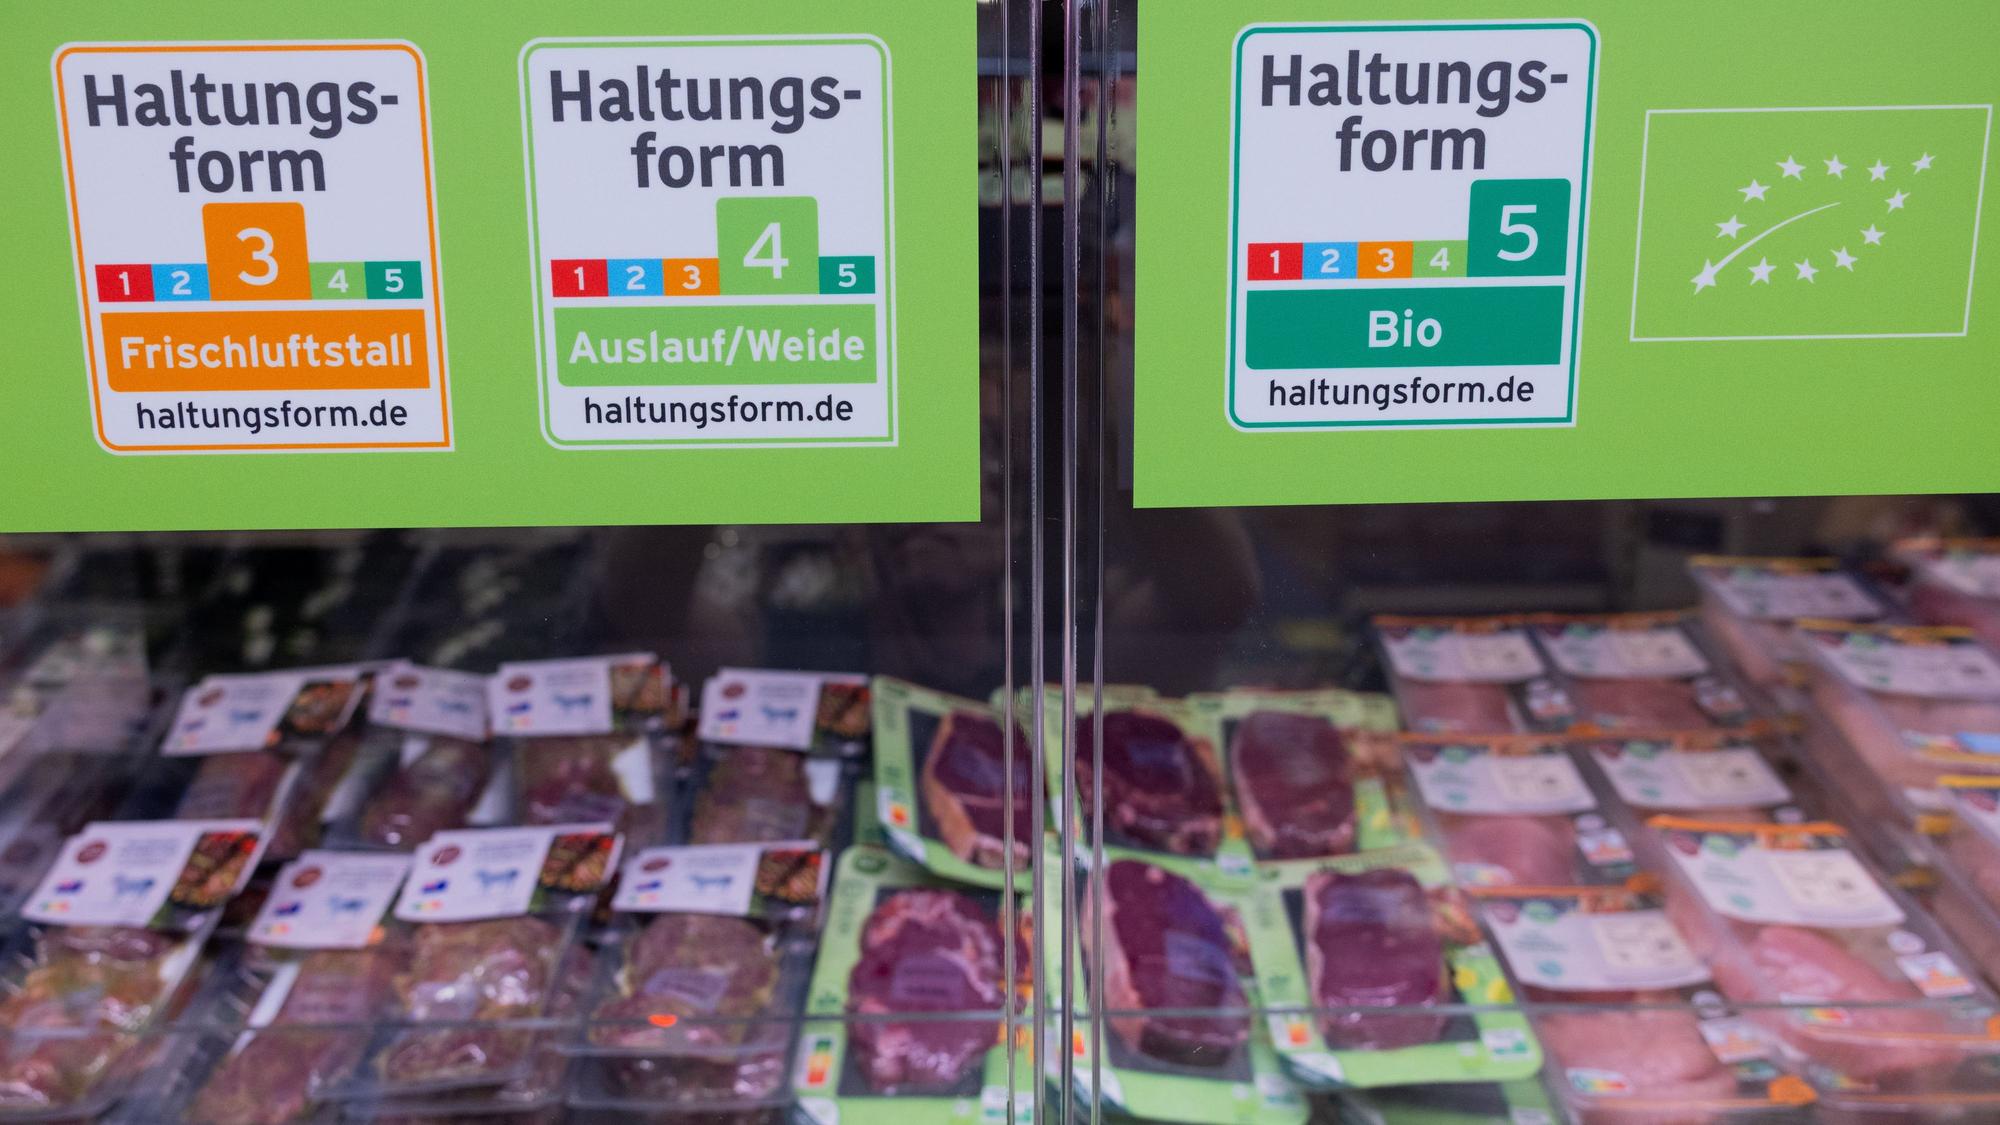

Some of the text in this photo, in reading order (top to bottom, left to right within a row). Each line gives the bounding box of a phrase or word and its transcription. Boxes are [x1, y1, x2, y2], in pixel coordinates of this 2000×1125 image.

[83, 70, 399, 139] Haltungs-
[549, 65, 862, 134] Haltungs-
[1260, 49, 1569, 118] Haltungs-
[169, 136, 326, 194] form
[630, 131, 785, 189] form
[1335, 115, 1486, 172] form
[118, 227, 404, 296] 1 2 3 4 5
[574, 222, 857, 291] 1 2 3 4 5
[1269, 204, 1539, 274] 1 2 3 4 5
[120, 333, 412, 369] Frischluftstall
[568, 326, 865, 366] Auslauf/Weide
[1368, 308, 1442, 348] Bio
[136, 399, 408, 434] haltungsform.de
[584, 394, 854, 429] haltungsform.de
[1269, 376, 1535, 410] haltungsform.de
